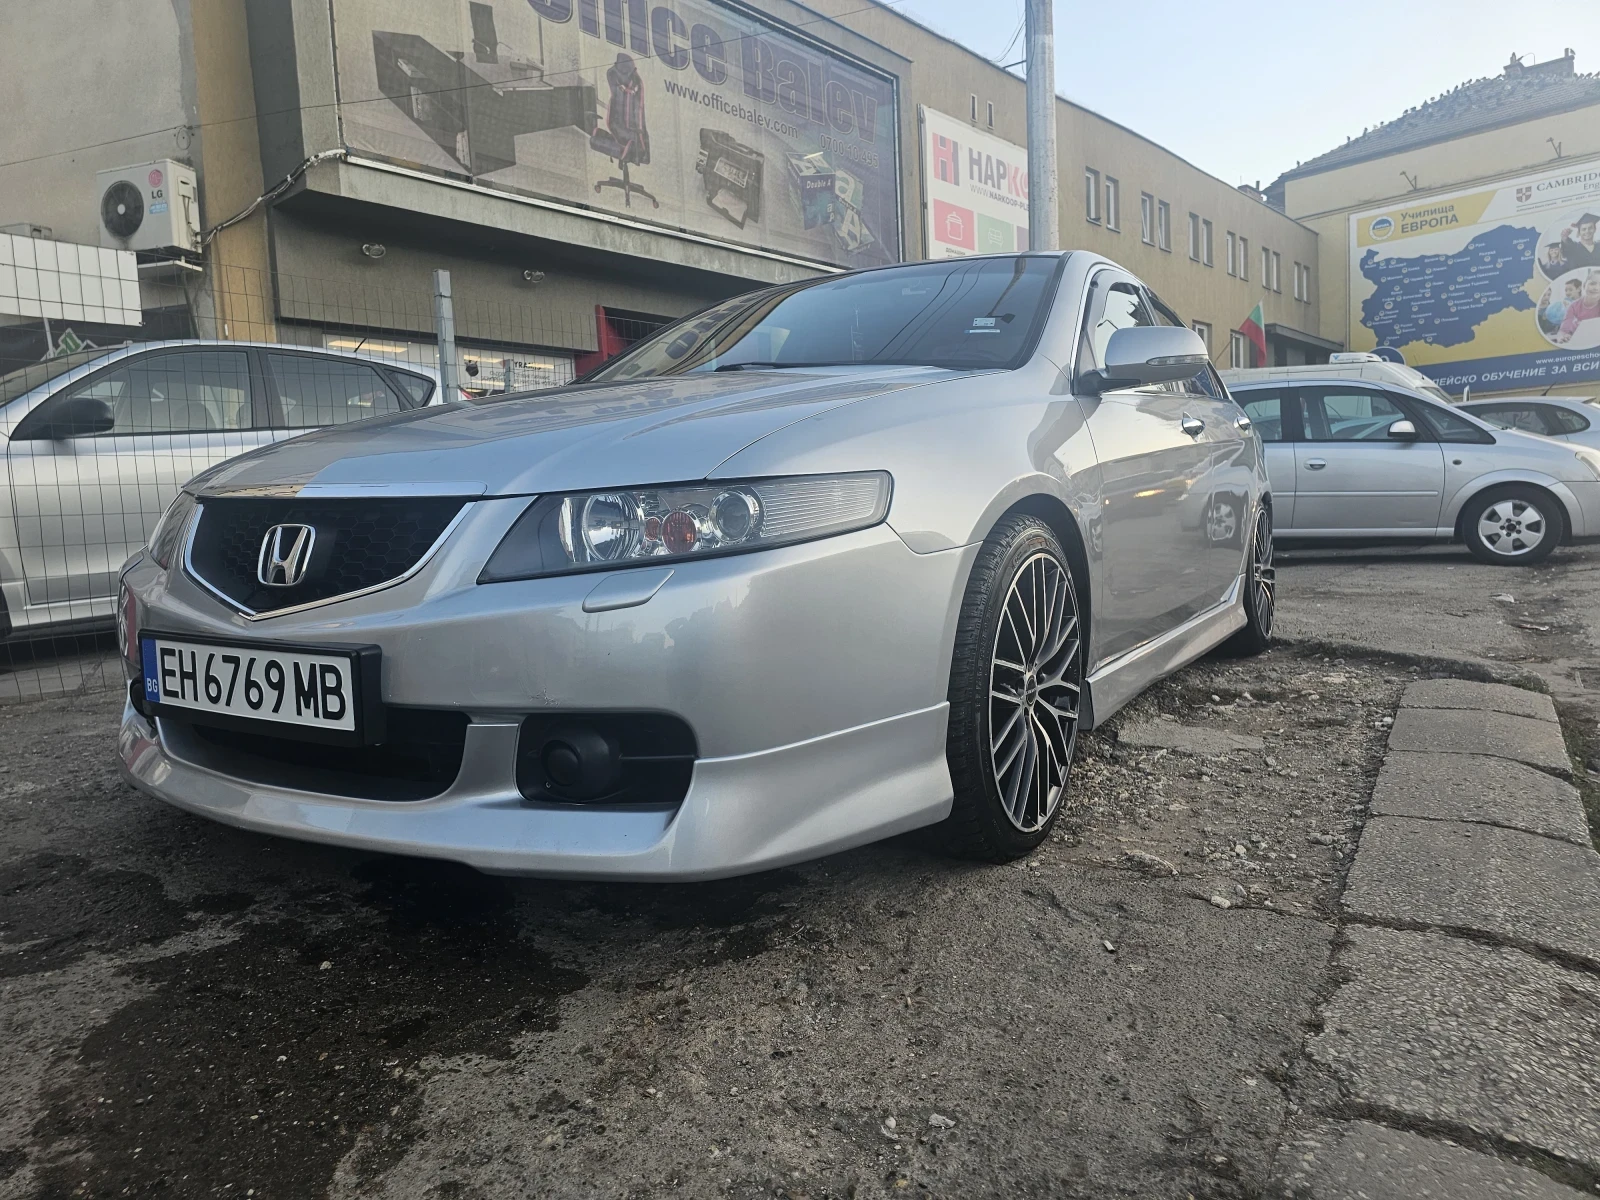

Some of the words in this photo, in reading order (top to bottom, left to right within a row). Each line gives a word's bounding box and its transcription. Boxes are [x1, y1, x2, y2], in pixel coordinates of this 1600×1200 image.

[739, 31, 877, 145] Balev
[664, 79, 798, 139] www.officebalev.com
[820, 134, 844, 155] 0700
[847, 145, 858, 162] 10
[862, 151, 879, 169] 495
[1536, 172, 1600, 192] CAMBRID
[151, 190, 163, 199] LG
[1400, 205, 1454, 221] Училища
[1401, 214, 1459, 233] ЕВРОПА
[1481, 367, 1547, 382] ОБУЧЕНИЕ
[1551, 364, 1567, 374] ЗА
[146, 677, 158, 693] BG
